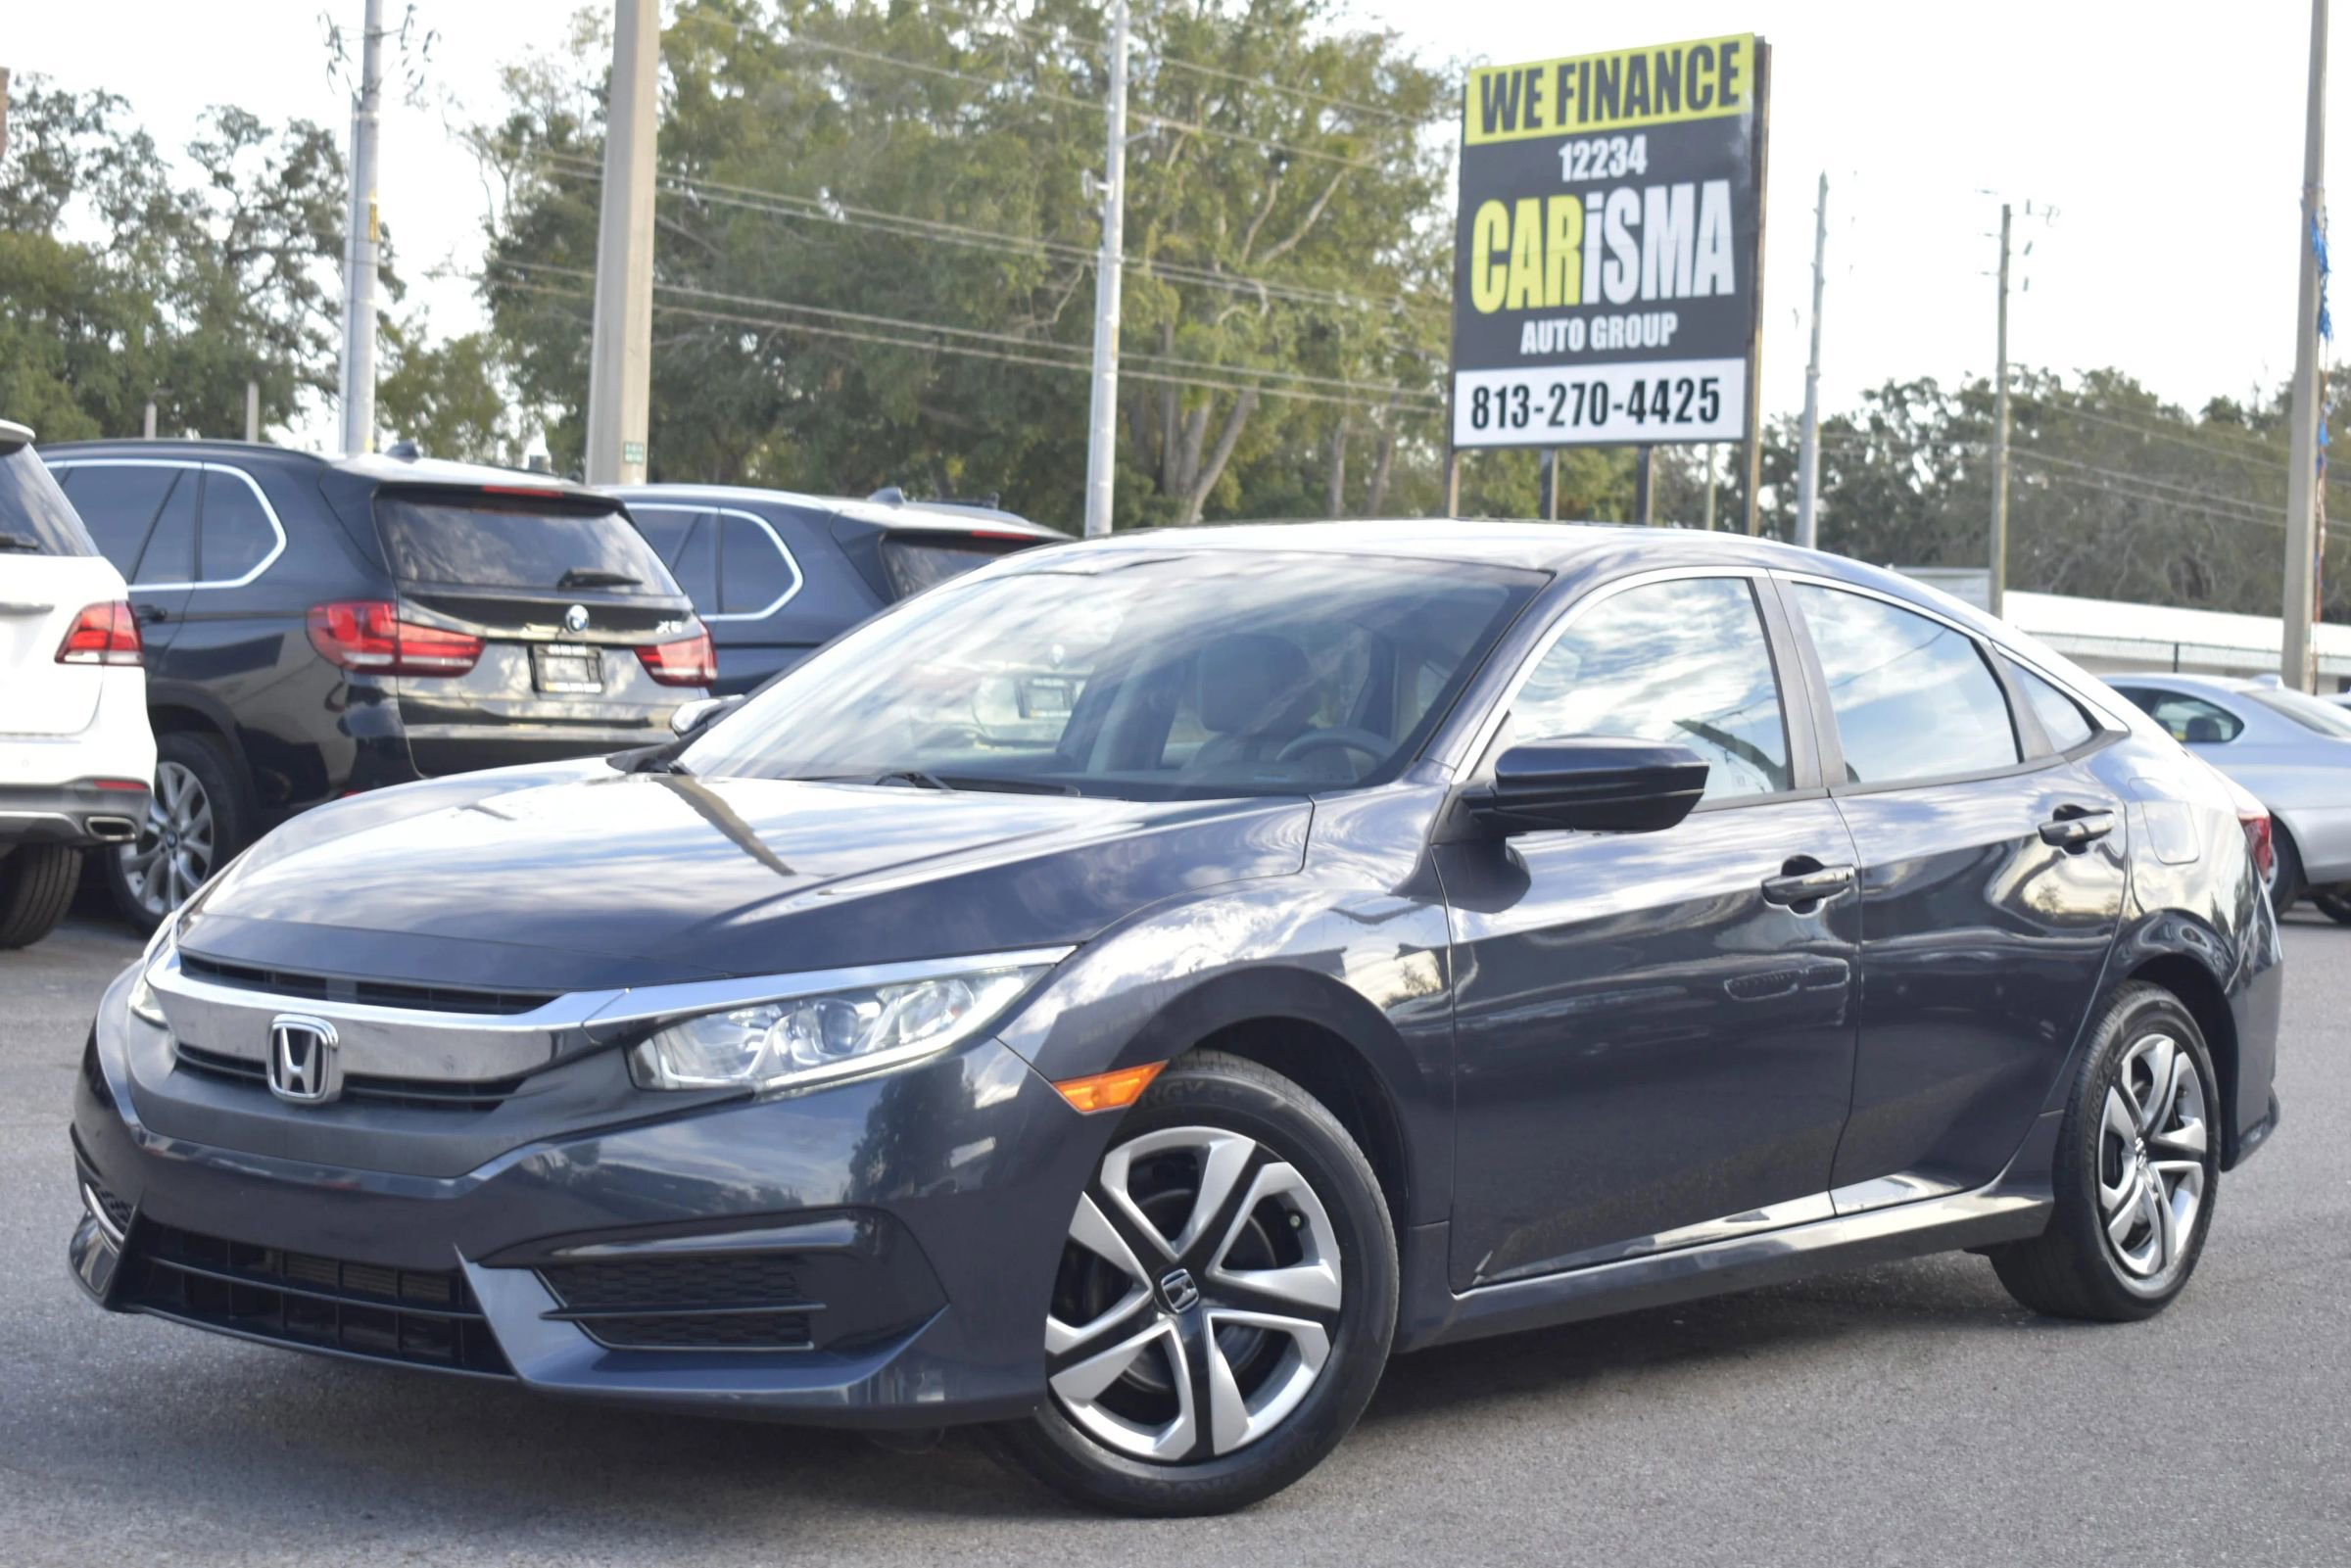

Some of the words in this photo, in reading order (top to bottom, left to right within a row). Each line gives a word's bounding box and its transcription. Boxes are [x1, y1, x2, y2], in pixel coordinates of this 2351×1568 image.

[1480, 67, 1544, 135] WE
[1556, 40, 1740, 126] FINANCE
[1559, 134, 1648, 182] 12234
[1471, 179, 1735, 313] CARiSMA
[1520, 317, 1585, 355] AUTO
[1590, 312, 1678, 350] GROUP
[1470, 377, 1720, 431] 813-270-4425
